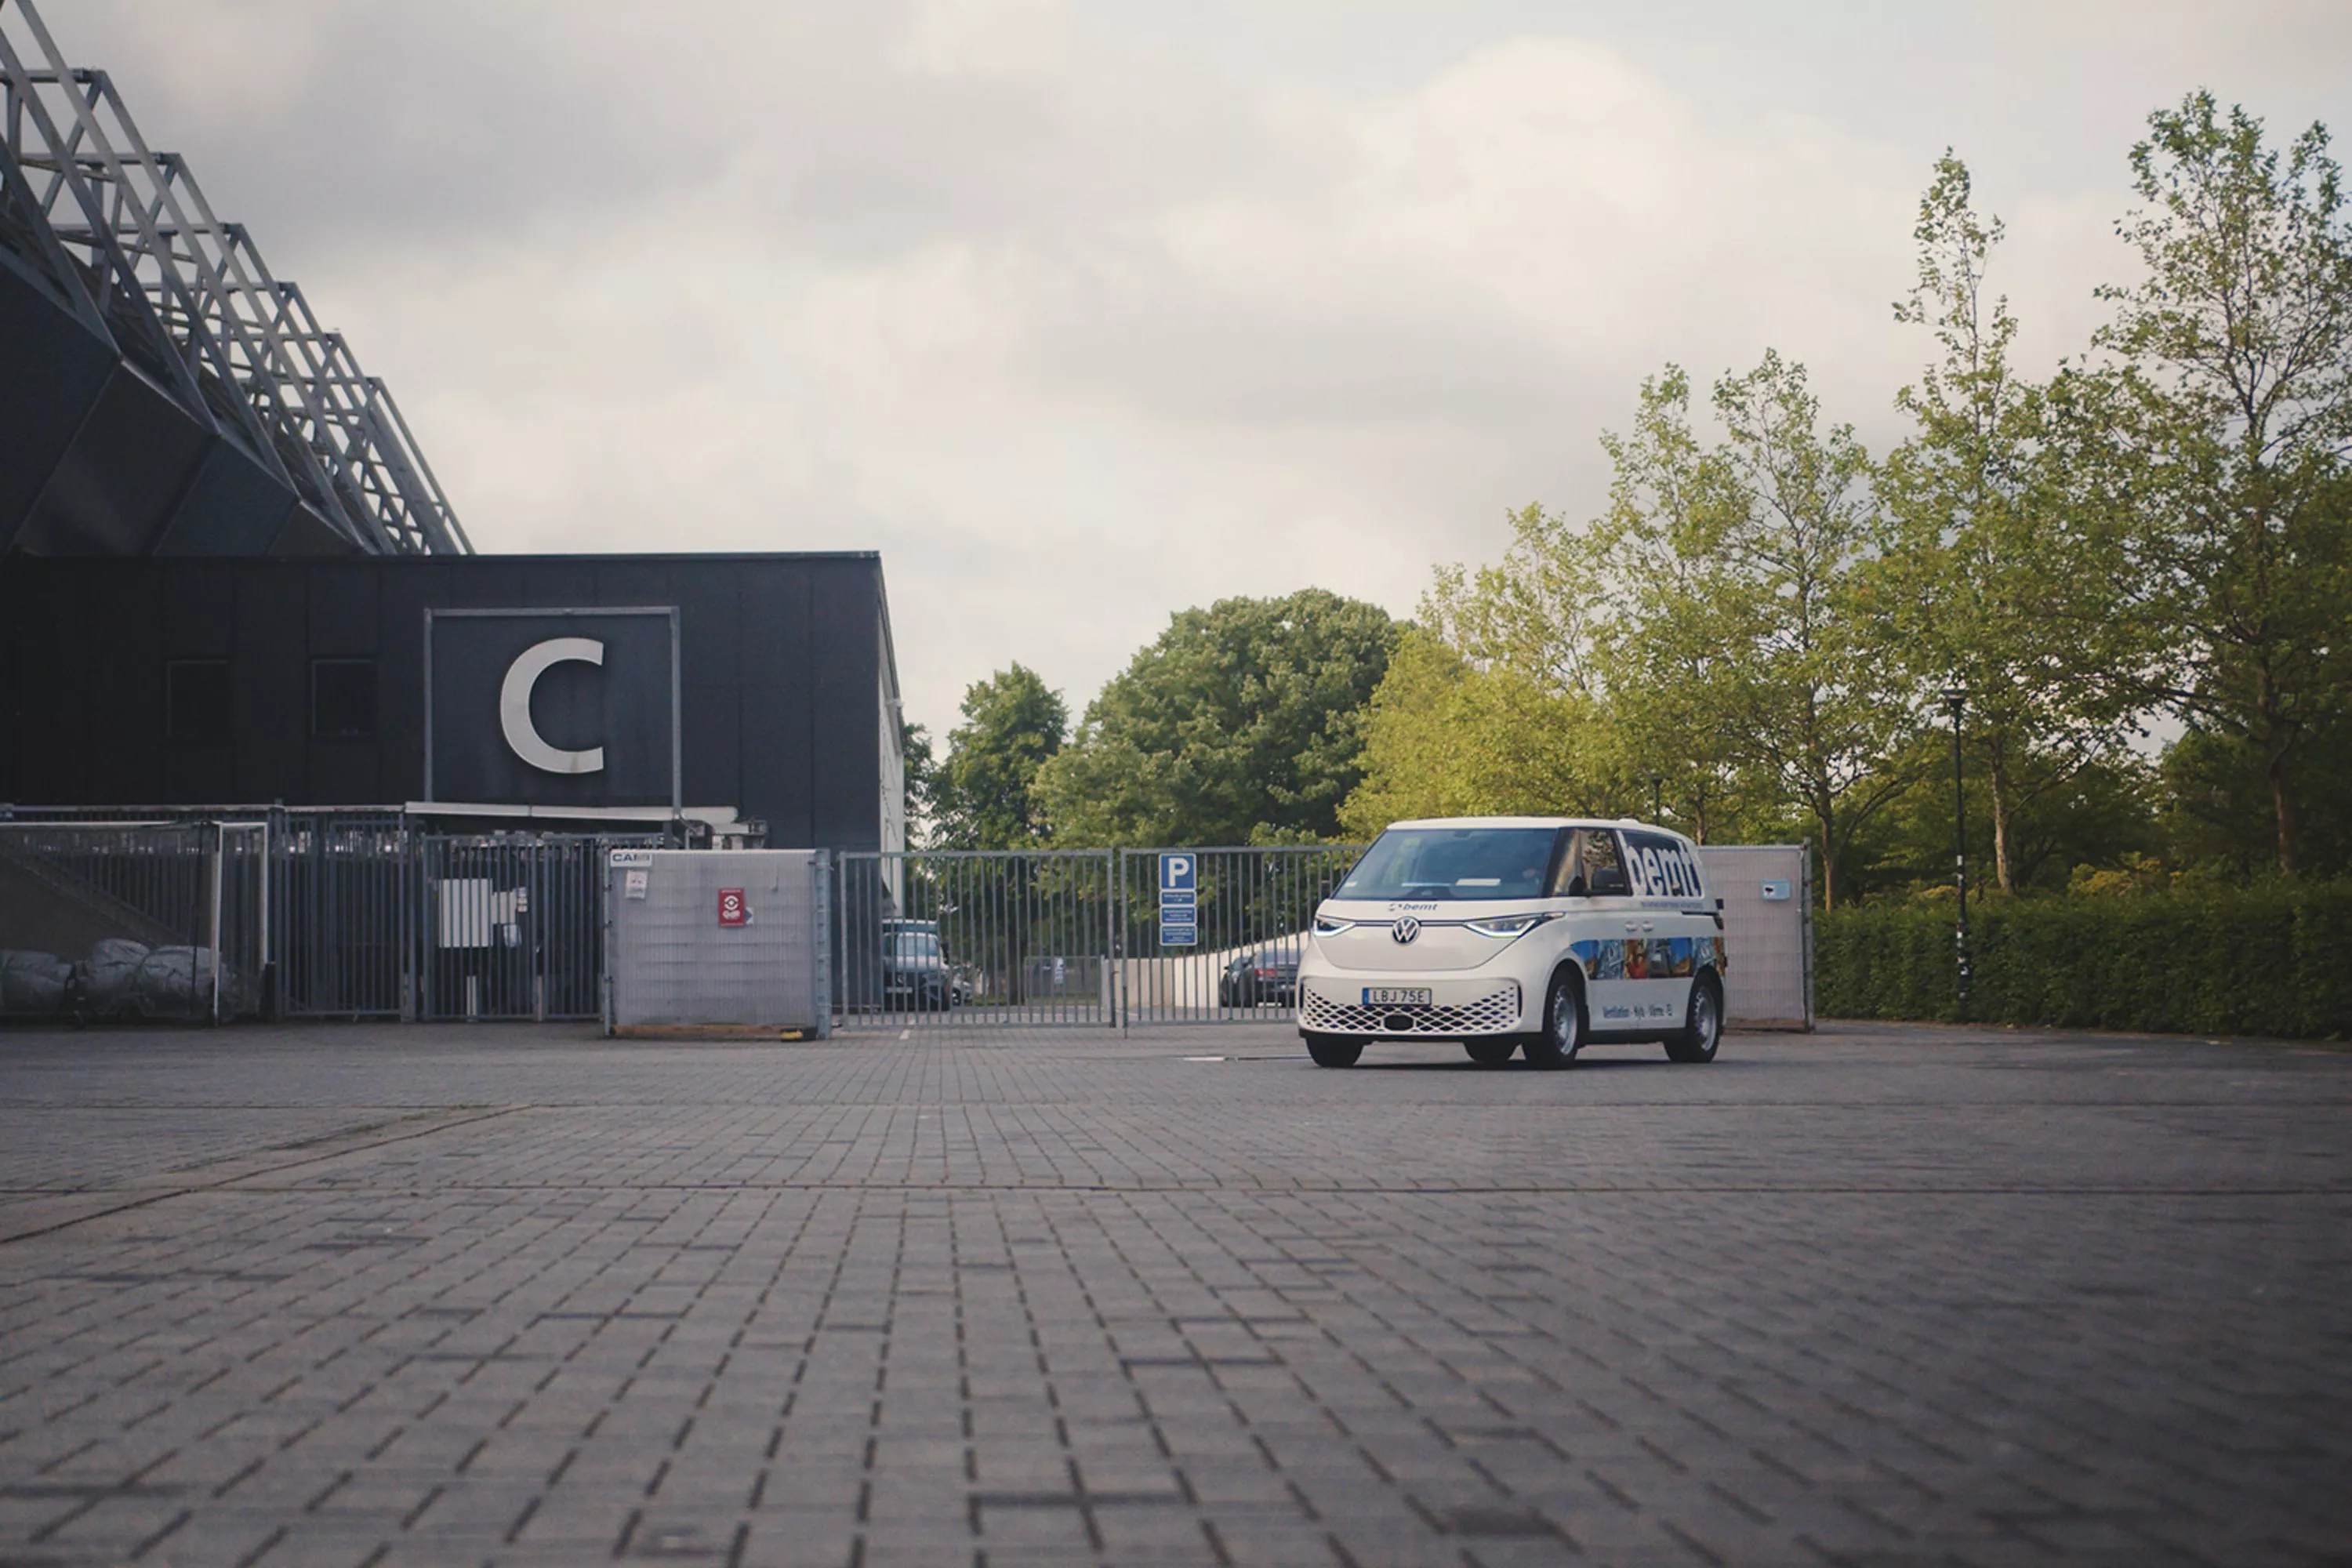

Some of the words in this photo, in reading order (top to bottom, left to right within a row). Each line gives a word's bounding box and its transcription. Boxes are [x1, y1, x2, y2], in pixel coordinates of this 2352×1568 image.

[499, 637, 604, 775] C
[1168, 857, 1190, 887] P
[1617, 829, 1700, 898] bemt
[1372, 989, 1397, 1003] LBJ
[1401, 989, 1425, 1003] 75E
